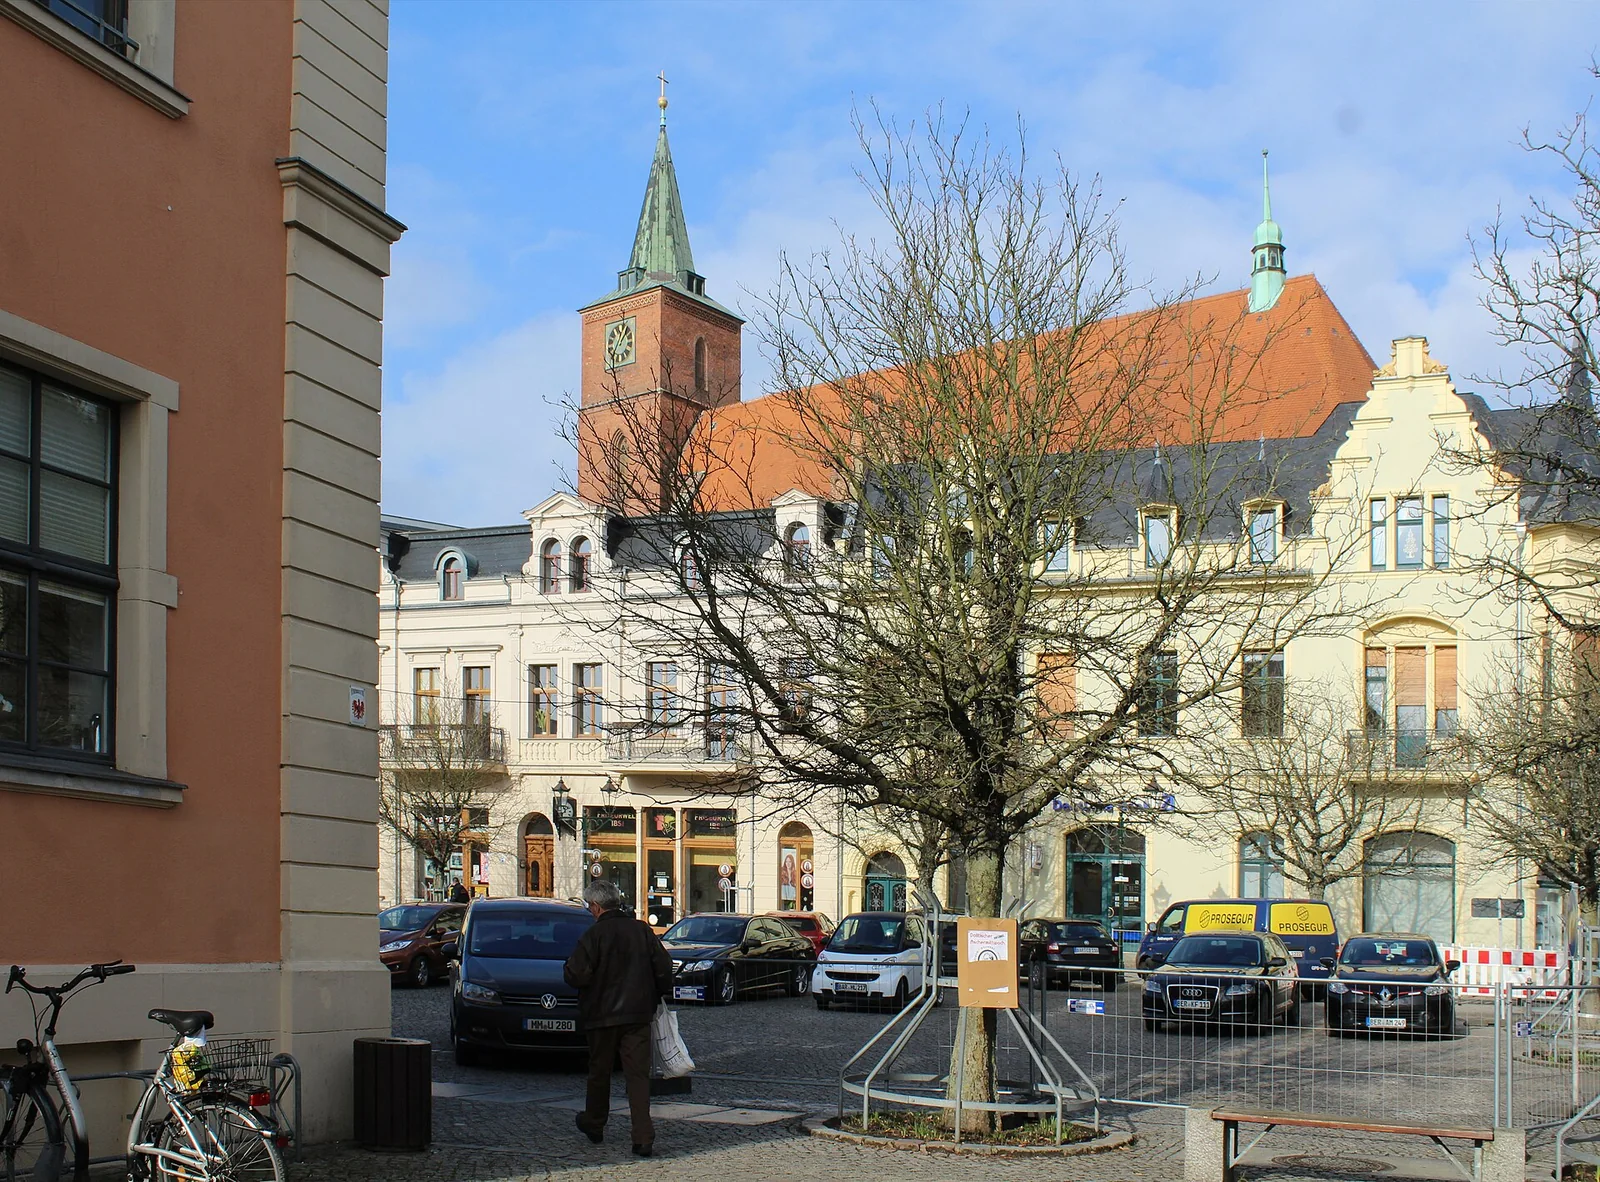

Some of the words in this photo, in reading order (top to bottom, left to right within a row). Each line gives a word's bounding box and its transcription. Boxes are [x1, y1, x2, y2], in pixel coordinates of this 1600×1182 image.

[1210, 913, 1254, 924] PROSEGUR
[1279, 922, 1329, 932] PROSEGUR
[555, 1020, 573, 1030] 280
